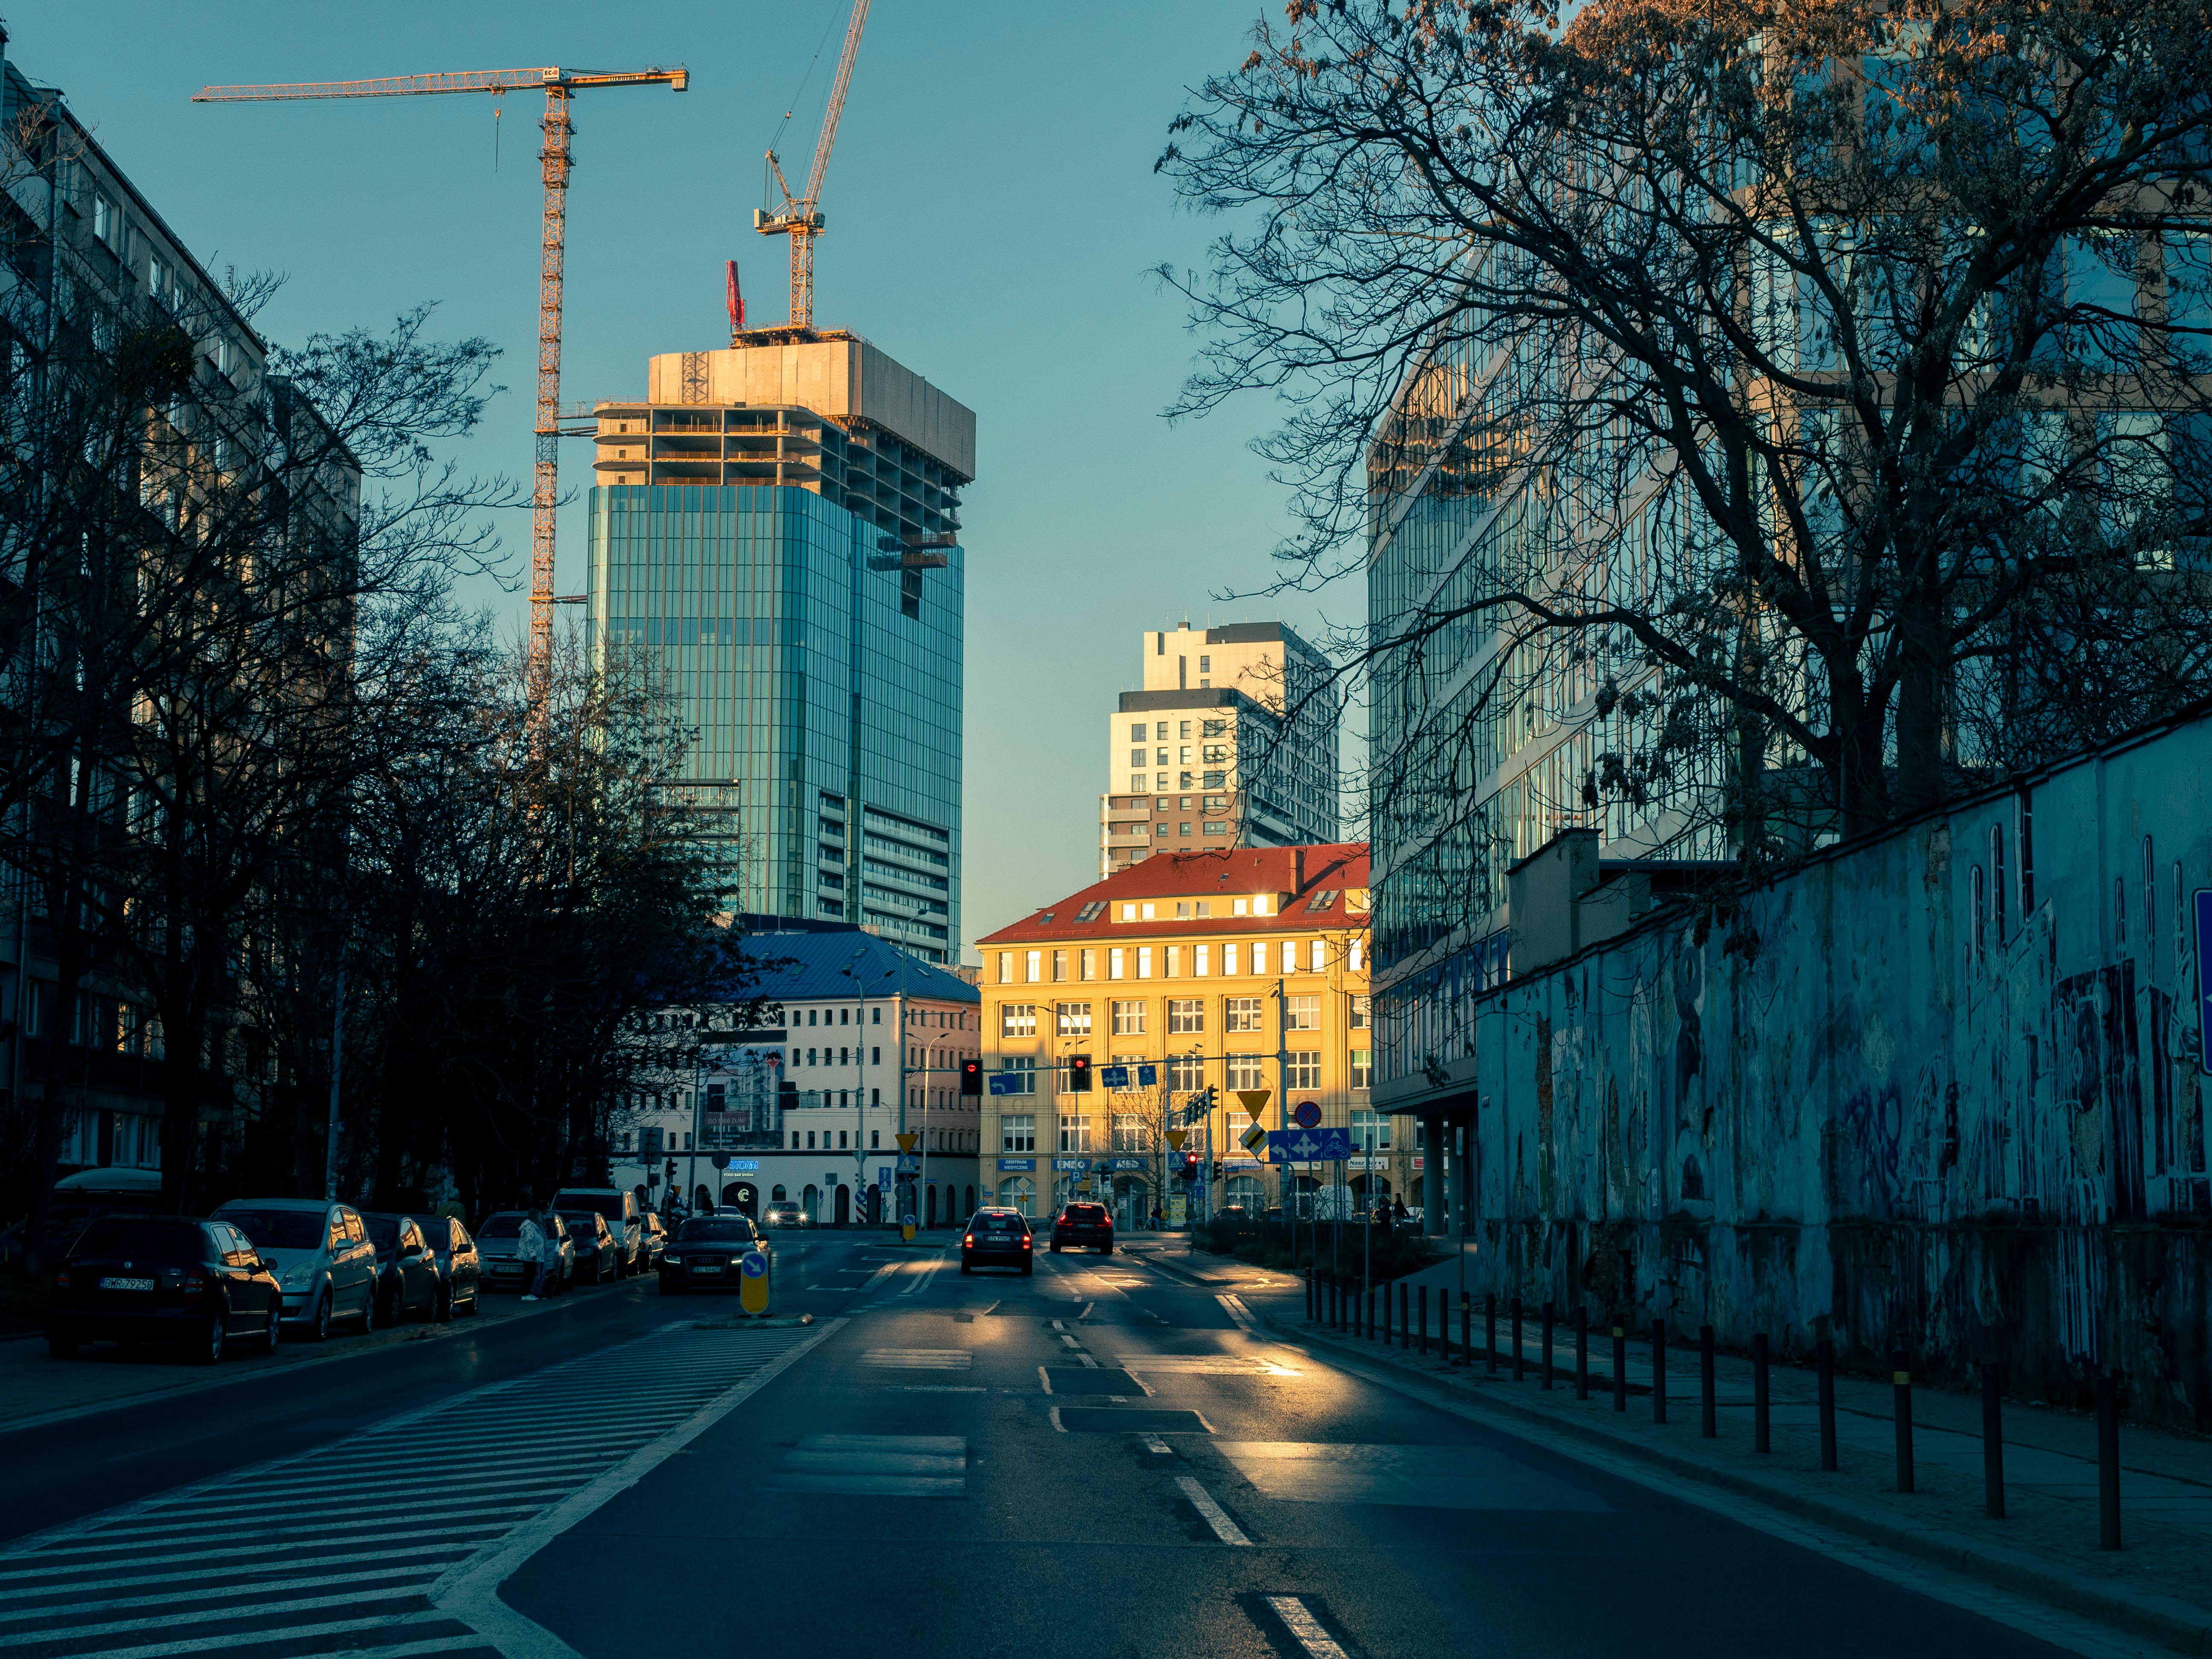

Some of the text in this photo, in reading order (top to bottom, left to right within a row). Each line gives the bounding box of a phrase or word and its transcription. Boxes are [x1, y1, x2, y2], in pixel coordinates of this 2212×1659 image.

[730, 1161, 758, 1170] STORM
[105, 1278, 152, 1289] DWR 79250
